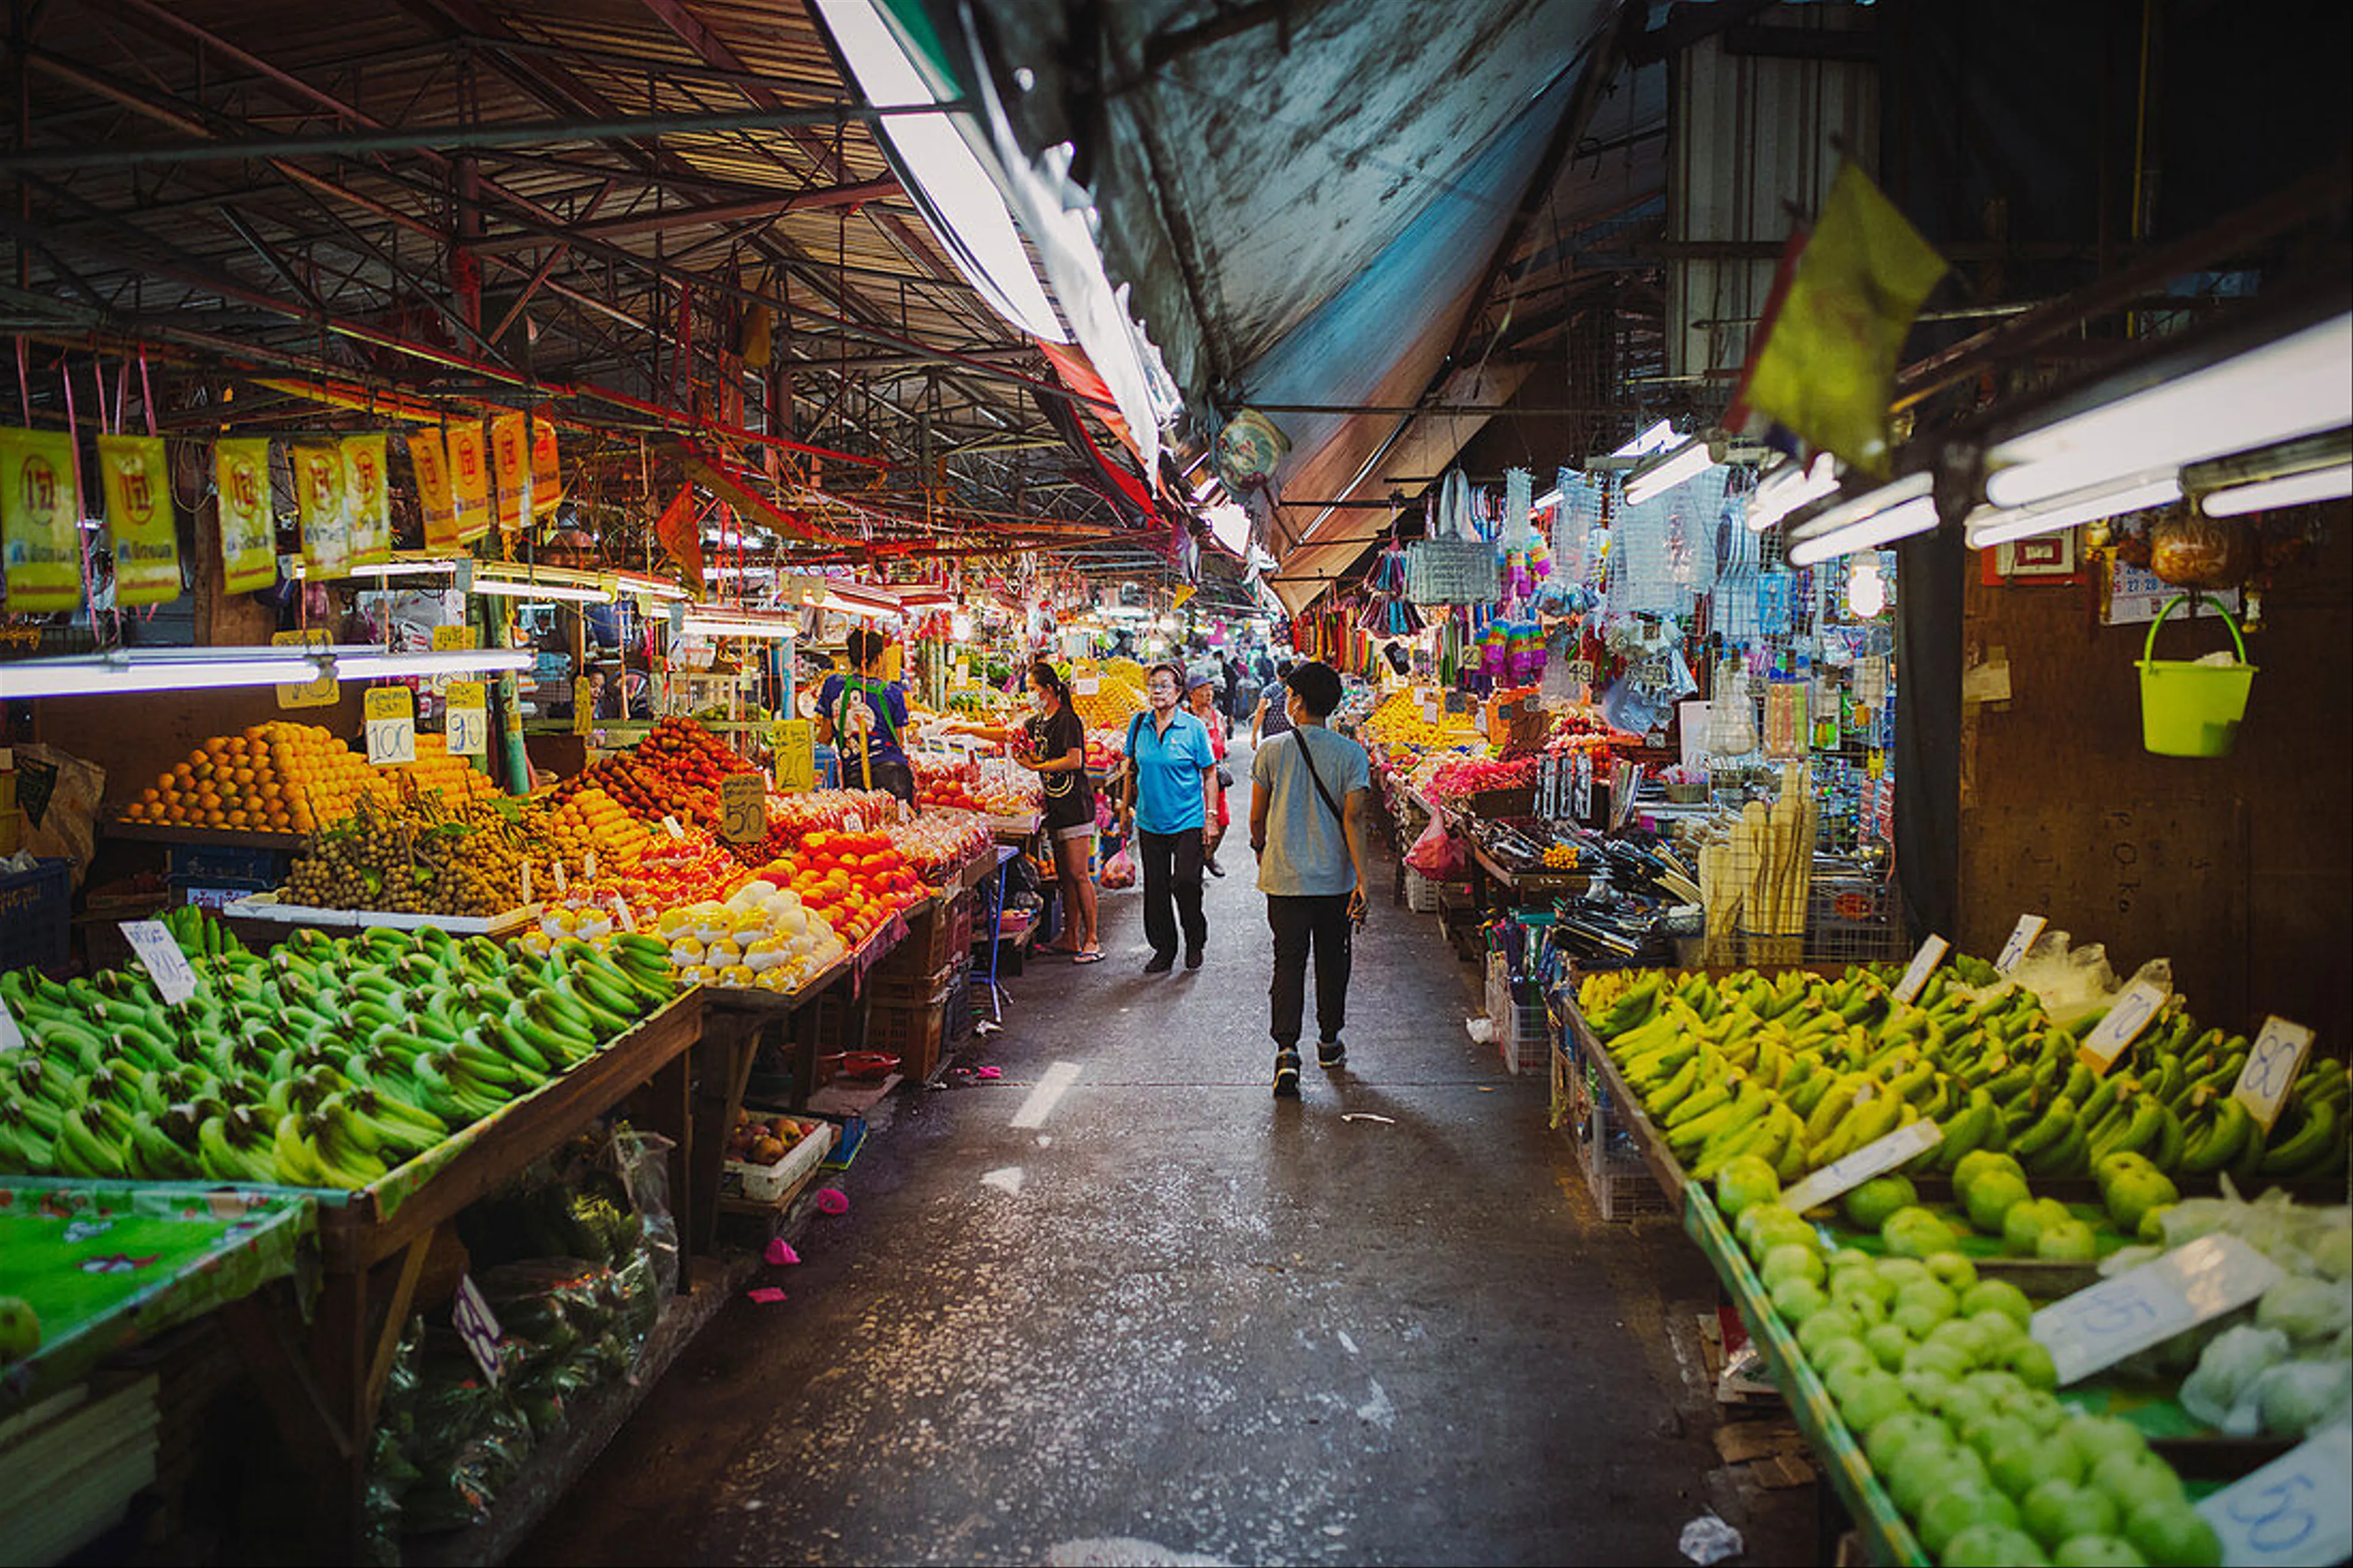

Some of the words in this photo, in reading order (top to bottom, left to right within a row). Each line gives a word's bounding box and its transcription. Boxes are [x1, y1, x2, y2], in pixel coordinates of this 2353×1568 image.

[369, 724, 412, 765] 100
[449, 713, 482, 752] 90
[726, 801, 762, 836] 50
[2243, 1034, 2297, 1099] 80
[2228, 1473, 2316, 1553] 50
